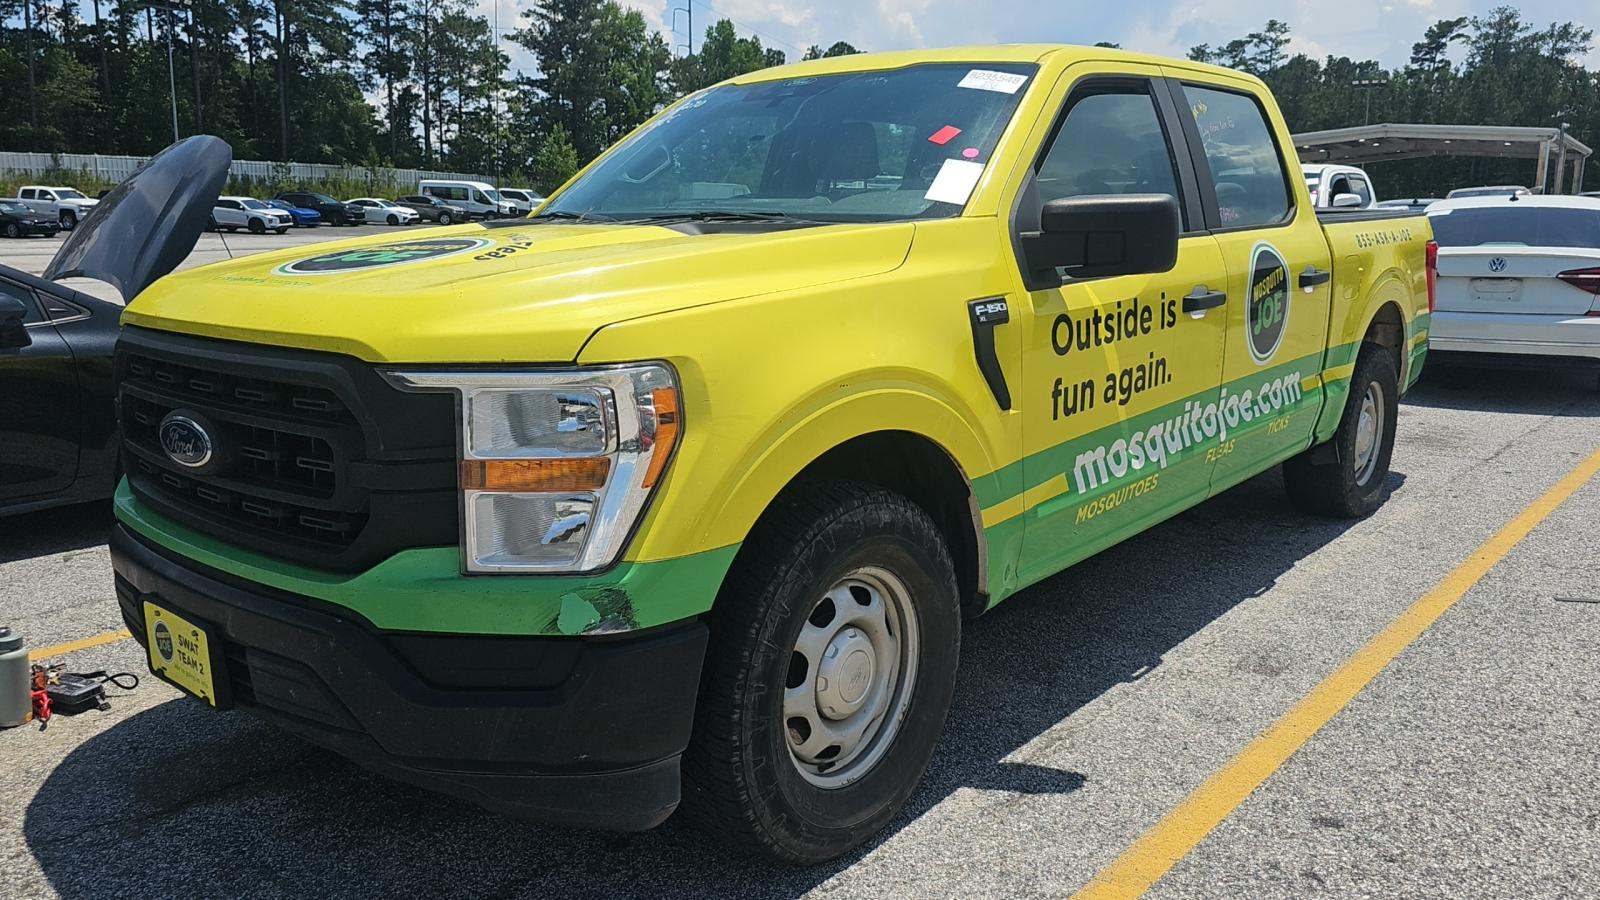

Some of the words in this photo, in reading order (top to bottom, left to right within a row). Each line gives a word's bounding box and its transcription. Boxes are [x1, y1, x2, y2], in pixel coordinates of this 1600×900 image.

[1355, 228, 1412, 248] 855-ASK-A-JOE
[1253, 266, 1284, 303] MOSQUITO
[975, 302, 1007, 316] F-150
[1051, 297, 1153, 356] Outside
[1160, 292, 1177, 330] is
[1254, 289, 1284, 336] JOE
[1052, 377, 1095, 421] fun
[1103, 351, 1172, 406] again.
[1073, 371, 1302, 495] mosquitojoe.com
[1075, 474, 1160, 525] MOSQUITOES
[1204, 438, 1237, 465] FLEAS
[1266, 416, 1291, 436] TICKS
[177, 649, 198, 671] TEAM
[199, 663, 205, 675] 2
[178, 634, 199, 655] SWAT
